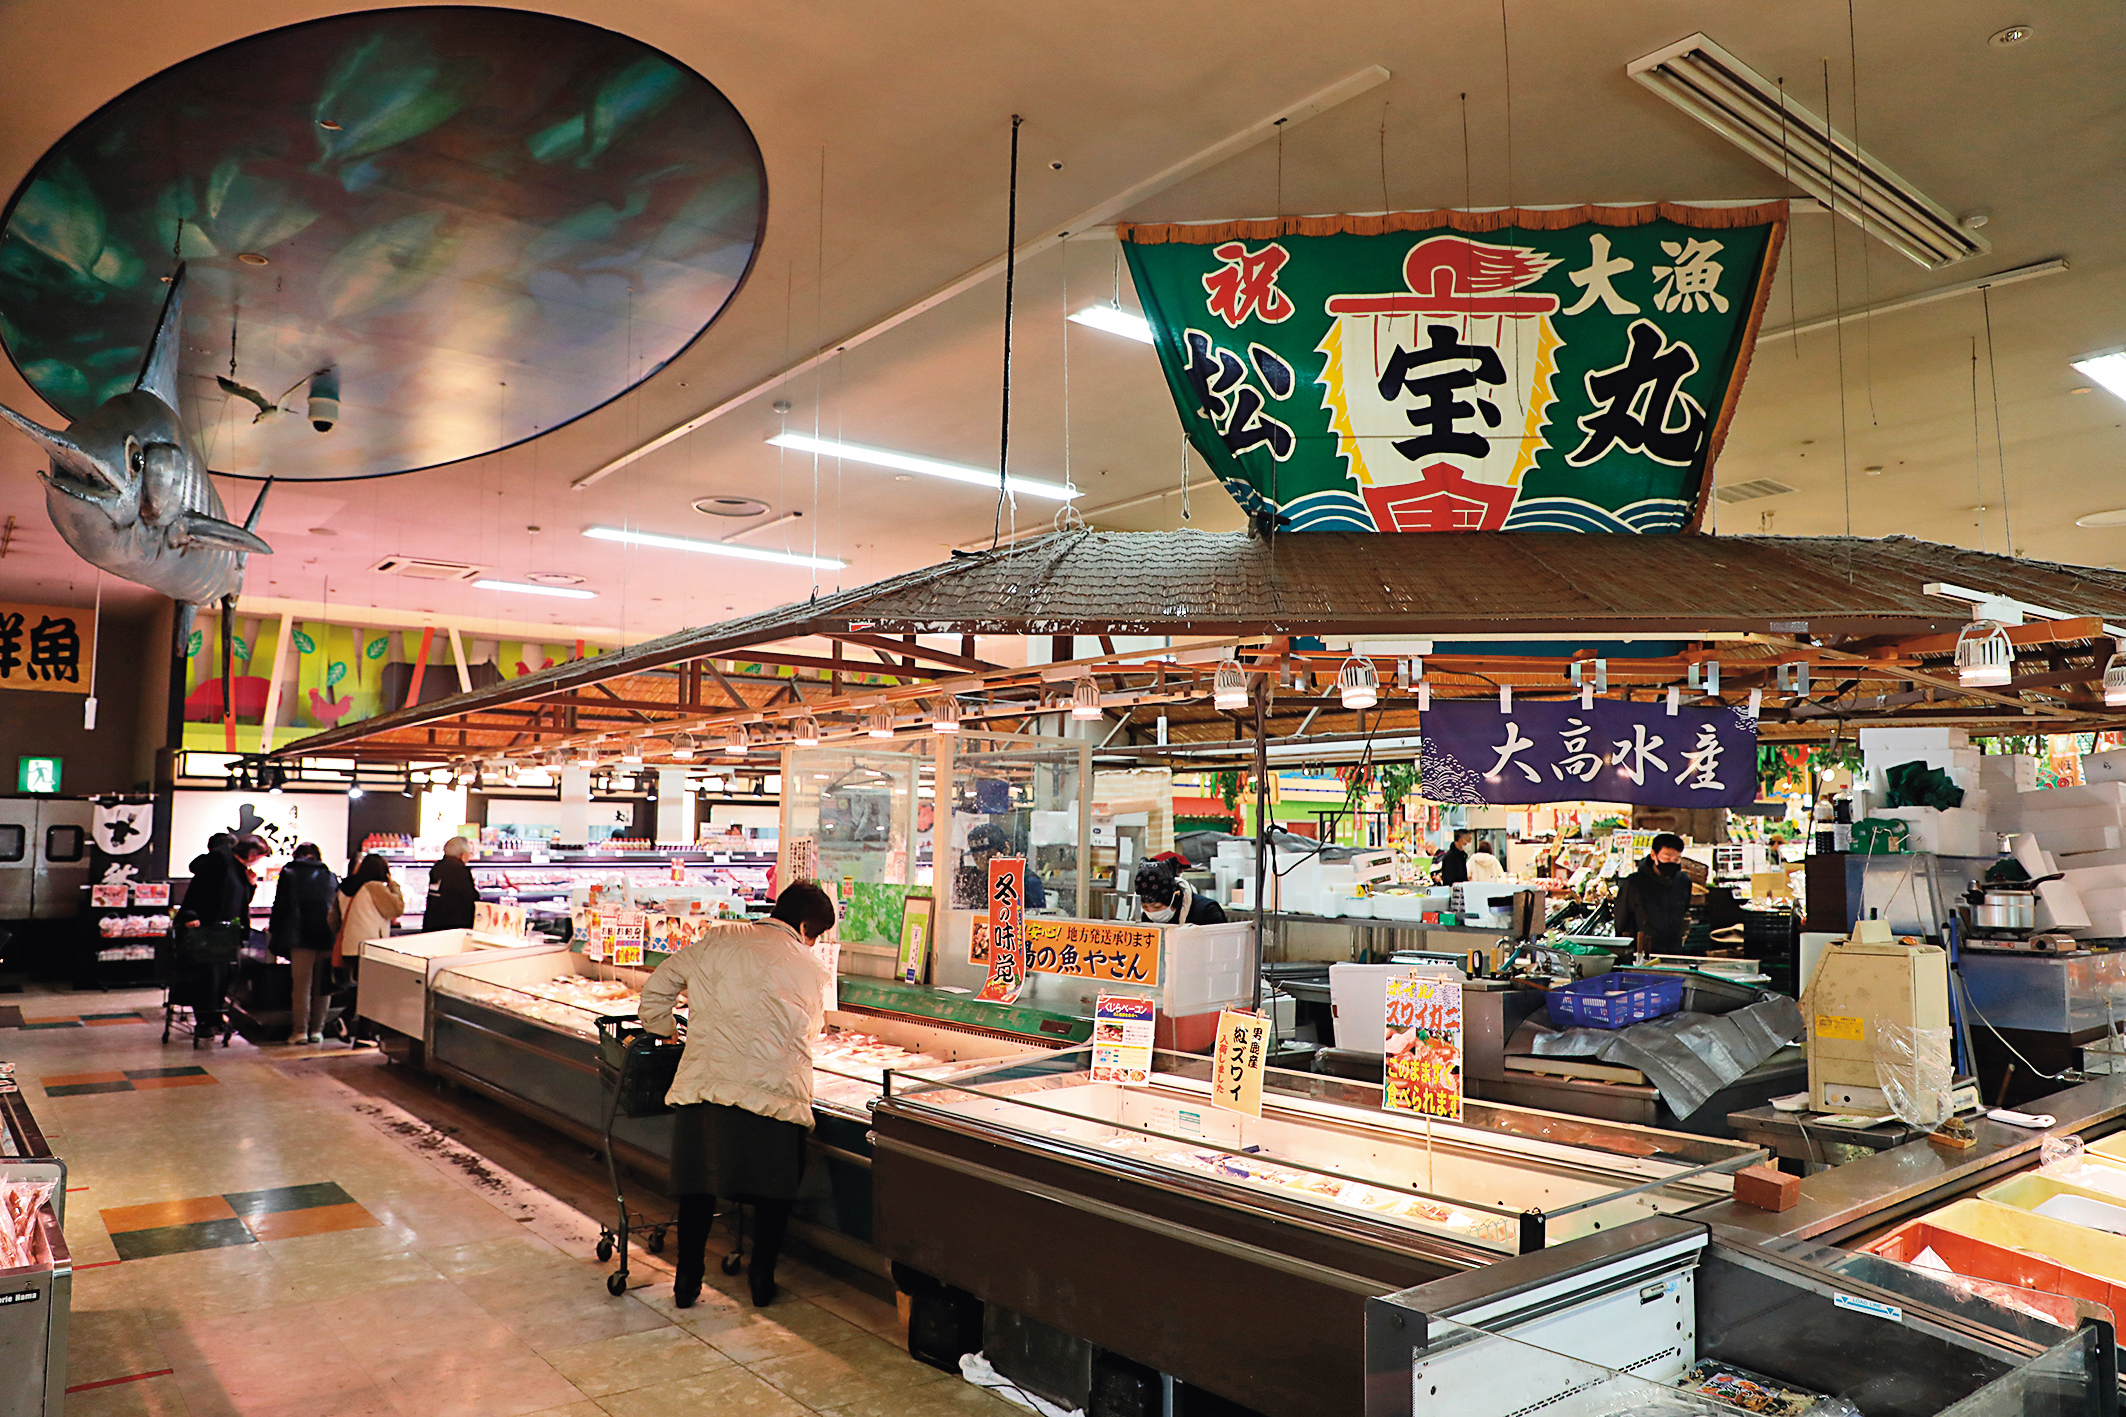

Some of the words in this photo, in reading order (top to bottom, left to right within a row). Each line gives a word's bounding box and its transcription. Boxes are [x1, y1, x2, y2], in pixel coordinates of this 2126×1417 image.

[1203, 242, 1296, 328] 祝
[1562, 233, 1729, 316] 大漁
[1482, 718, 1727, 791] 大高水産
[993, 872, 1017, 983] 冬の味覚
[1066, 926, 1155, 949] 地方発送承ります
[1387, 980, 1434, 999] ボイル
[1104, 1002, 1148, 1015] くじらベーコン
[1386, 1000, 1460, 1029] ズワイガニ
[1216, 1034, 1229, 1094] 入荷しました
[1387, 1058, 1455, 1086] このまますぐ
[1385, 1082, 1460, 1118] 食べられます
[1852, 1297, 1868, 1306] LOAD
[1870, 1301, 1883, 1309] LINE
